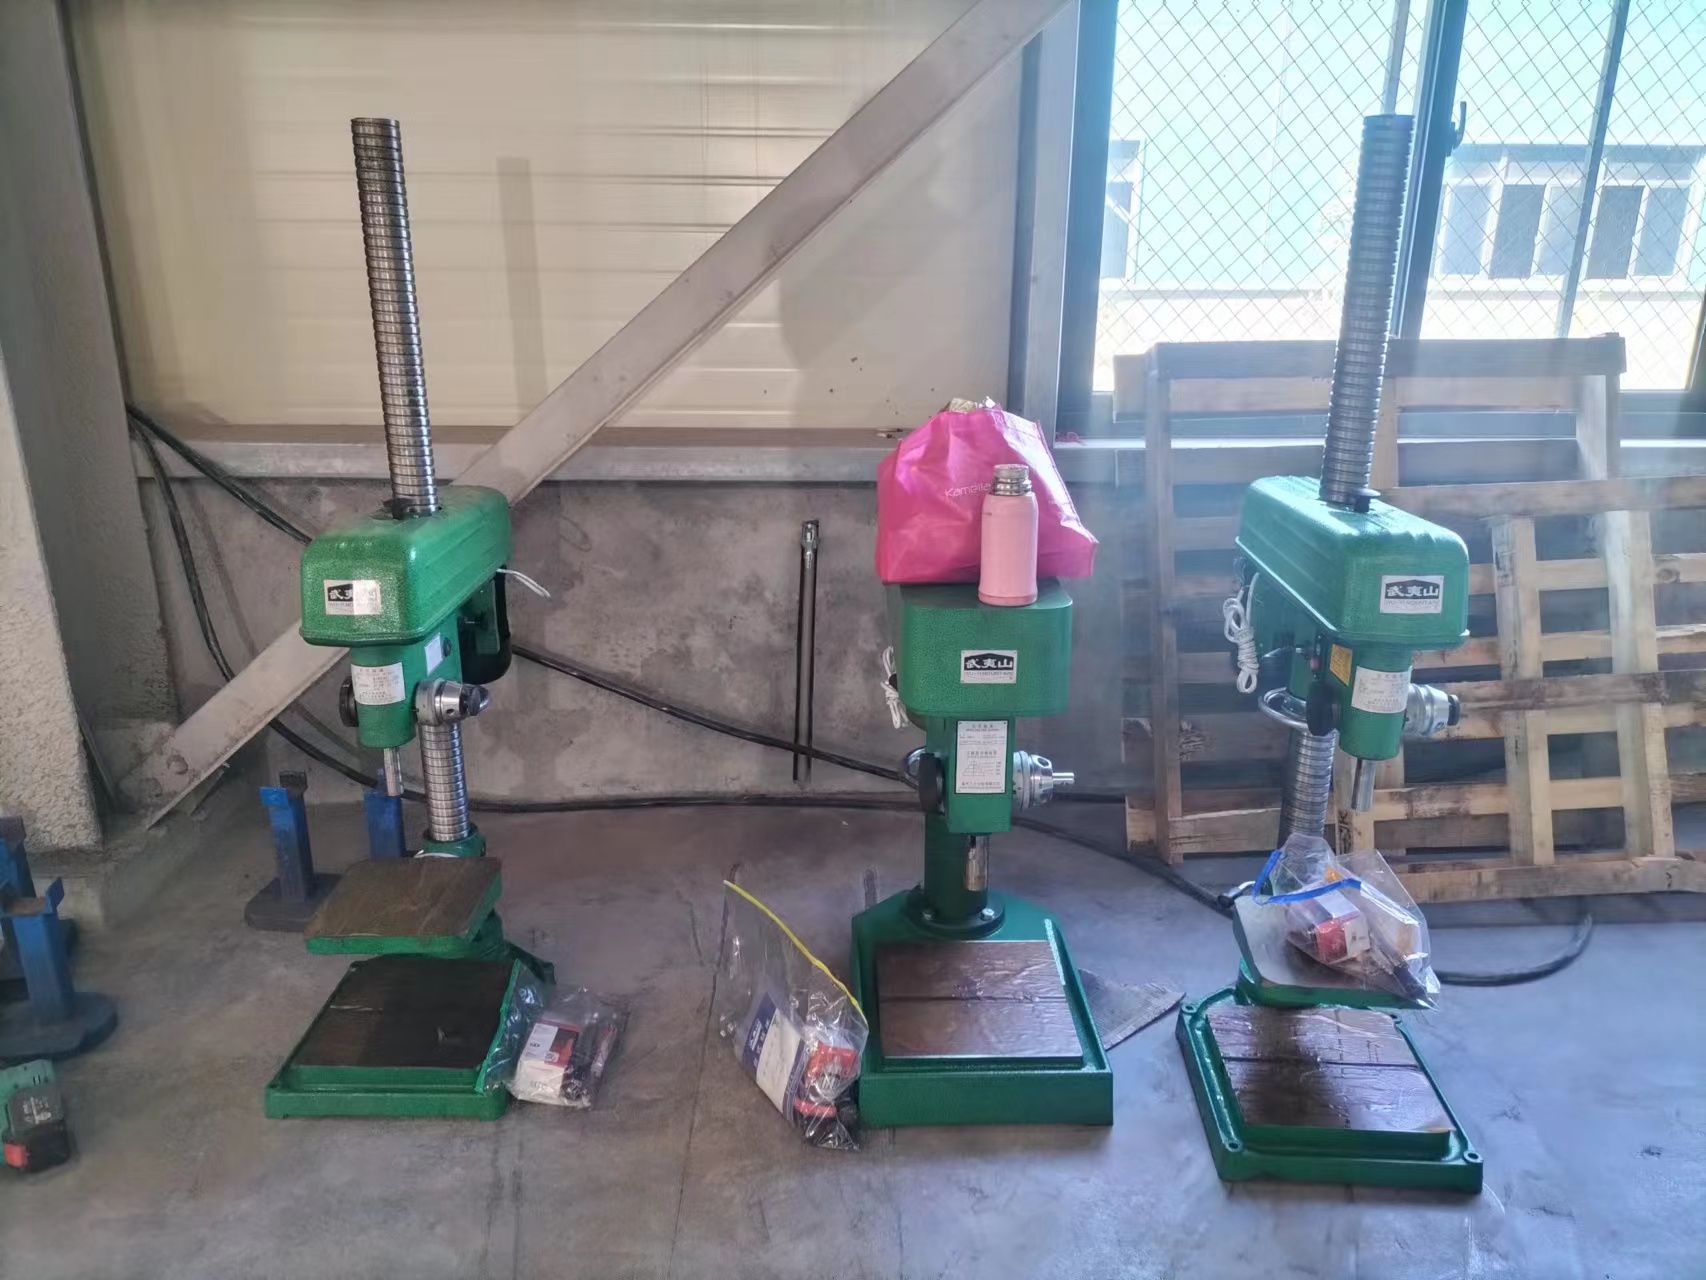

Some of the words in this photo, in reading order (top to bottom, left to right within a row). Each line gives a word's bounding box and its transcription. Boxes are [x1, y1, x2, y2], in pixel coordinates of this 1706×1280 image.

[1387, 586, 1438, 596] 武夷山
[965, 658, 1012, 669] 武夷山
